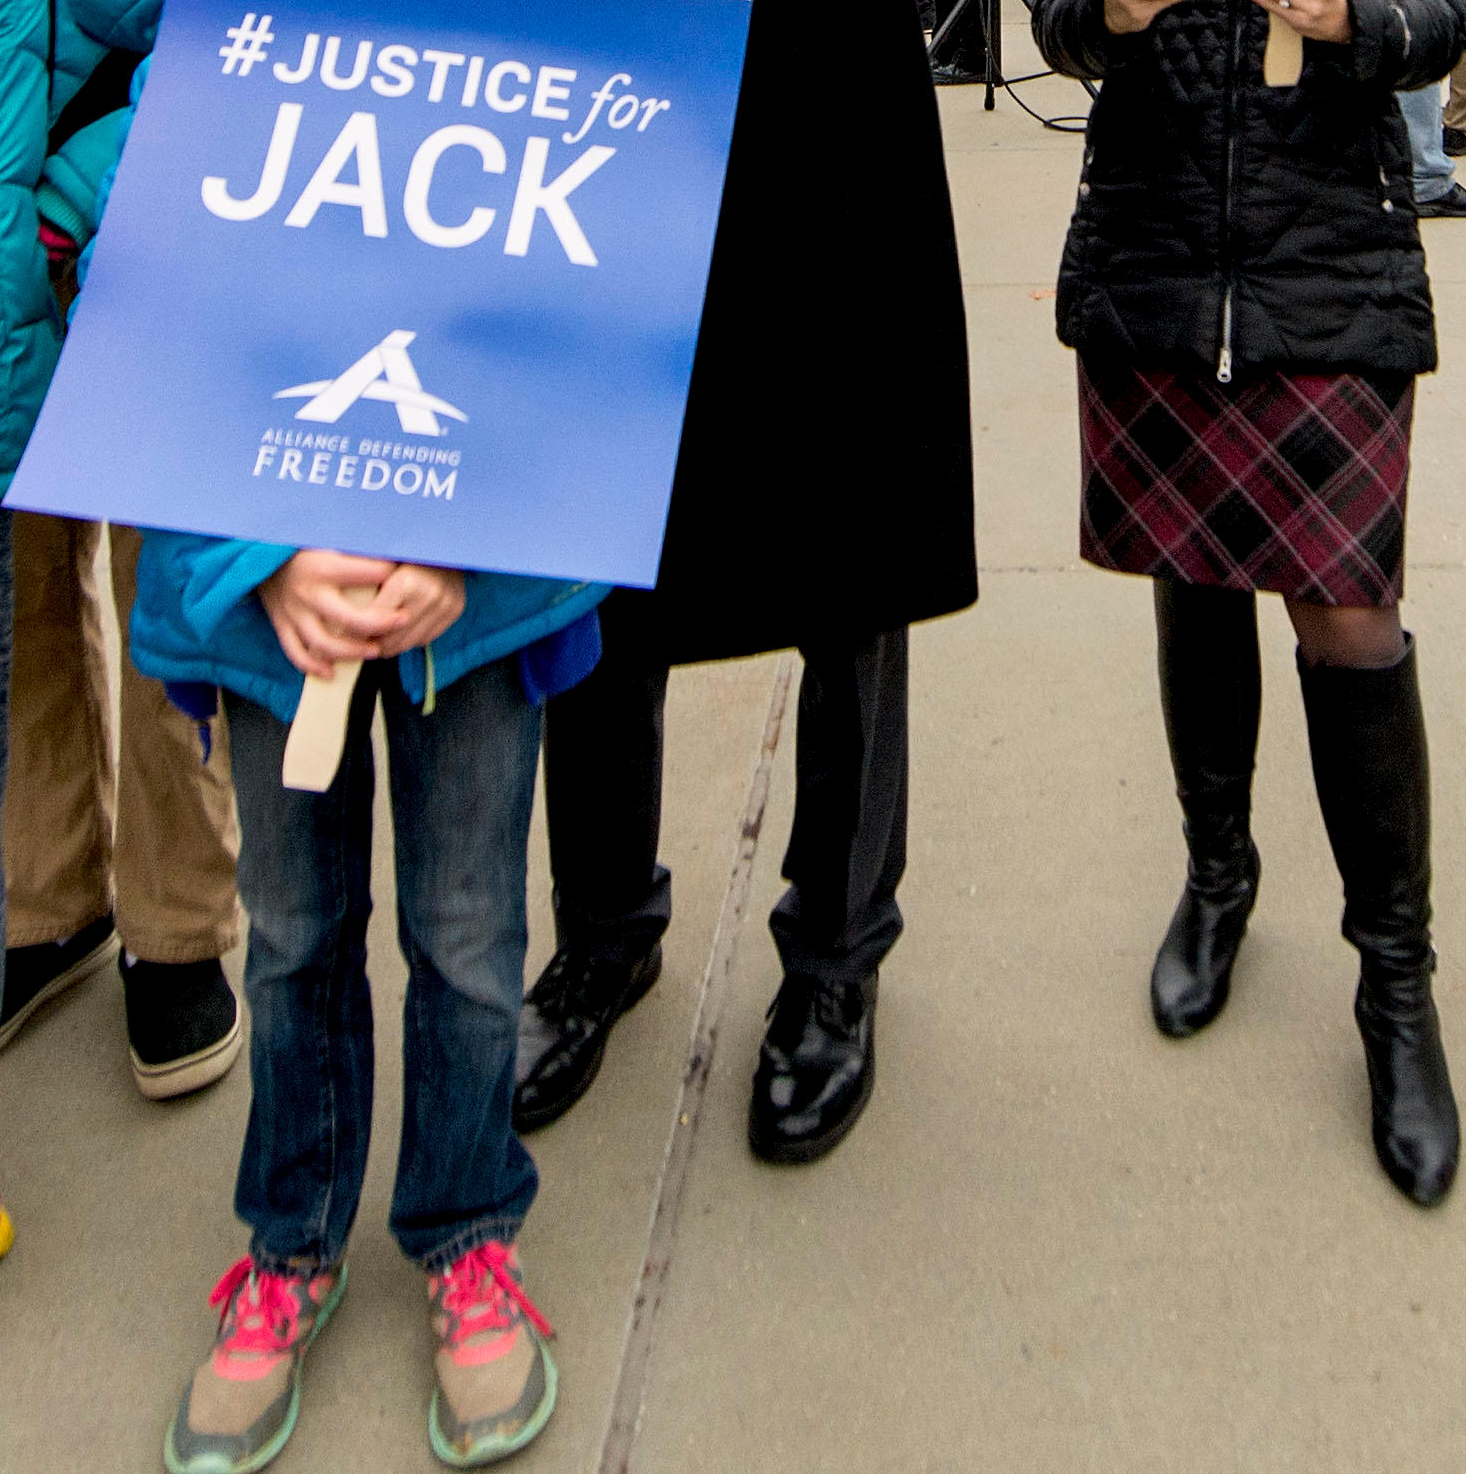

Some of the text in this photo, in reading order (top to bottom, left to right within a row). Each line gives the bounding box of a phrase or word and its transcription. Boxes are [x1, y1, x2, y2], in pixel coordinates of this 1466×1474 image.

[218, 12, 671, 144] #JUSTICE for
[201, 102, 617, 267] JACK
[251, 444, 459, 501] FREEDOM
[259, 427, 463, 468] ALLIANCE DEFENDING
